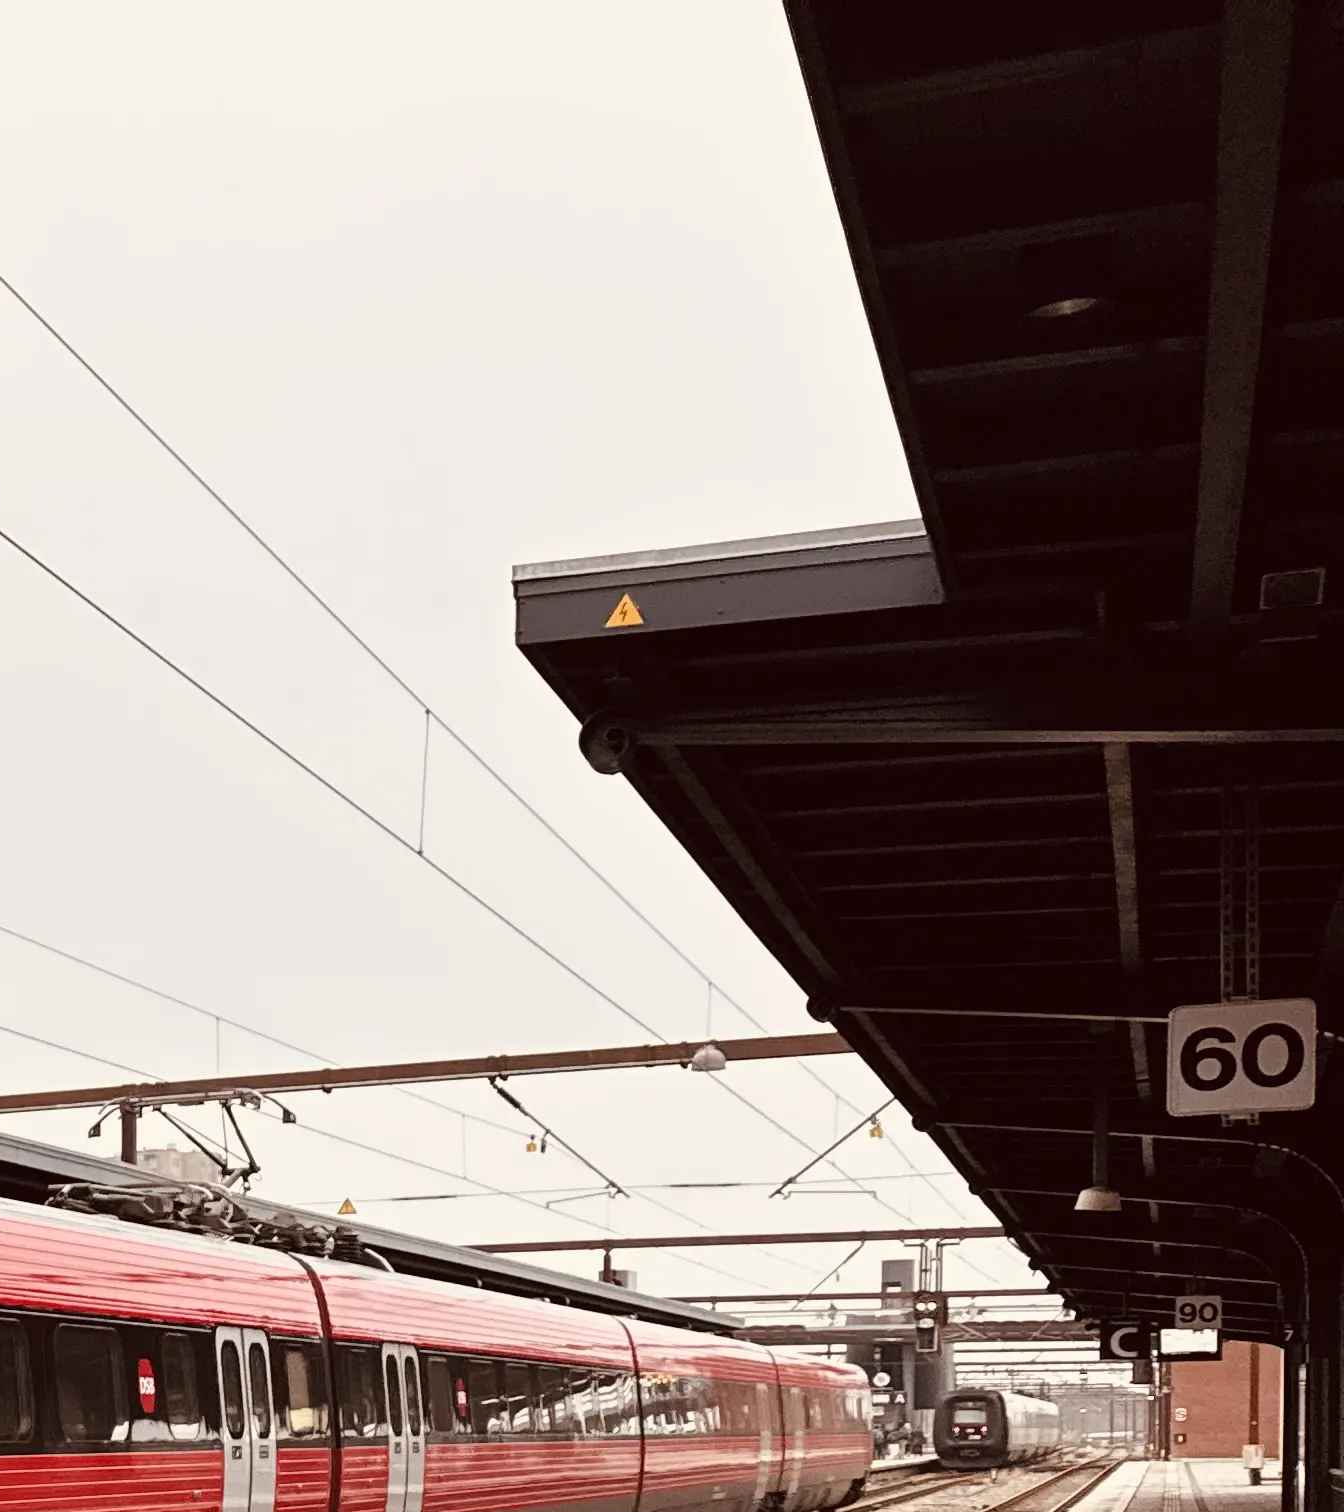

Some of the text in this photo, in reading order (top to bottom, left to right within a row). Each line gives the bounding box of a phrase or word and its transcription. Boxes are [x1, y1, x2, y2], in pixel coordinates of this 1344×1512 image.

[1180, 1022, 1305, 1092] 60
[1179, 1302, 1219, 1323] 90
[1110, 1327, 1139, 1357] C
[1284, 1330, 1294, 1341] 7
[139, 1376, 155, 1395] DSB
